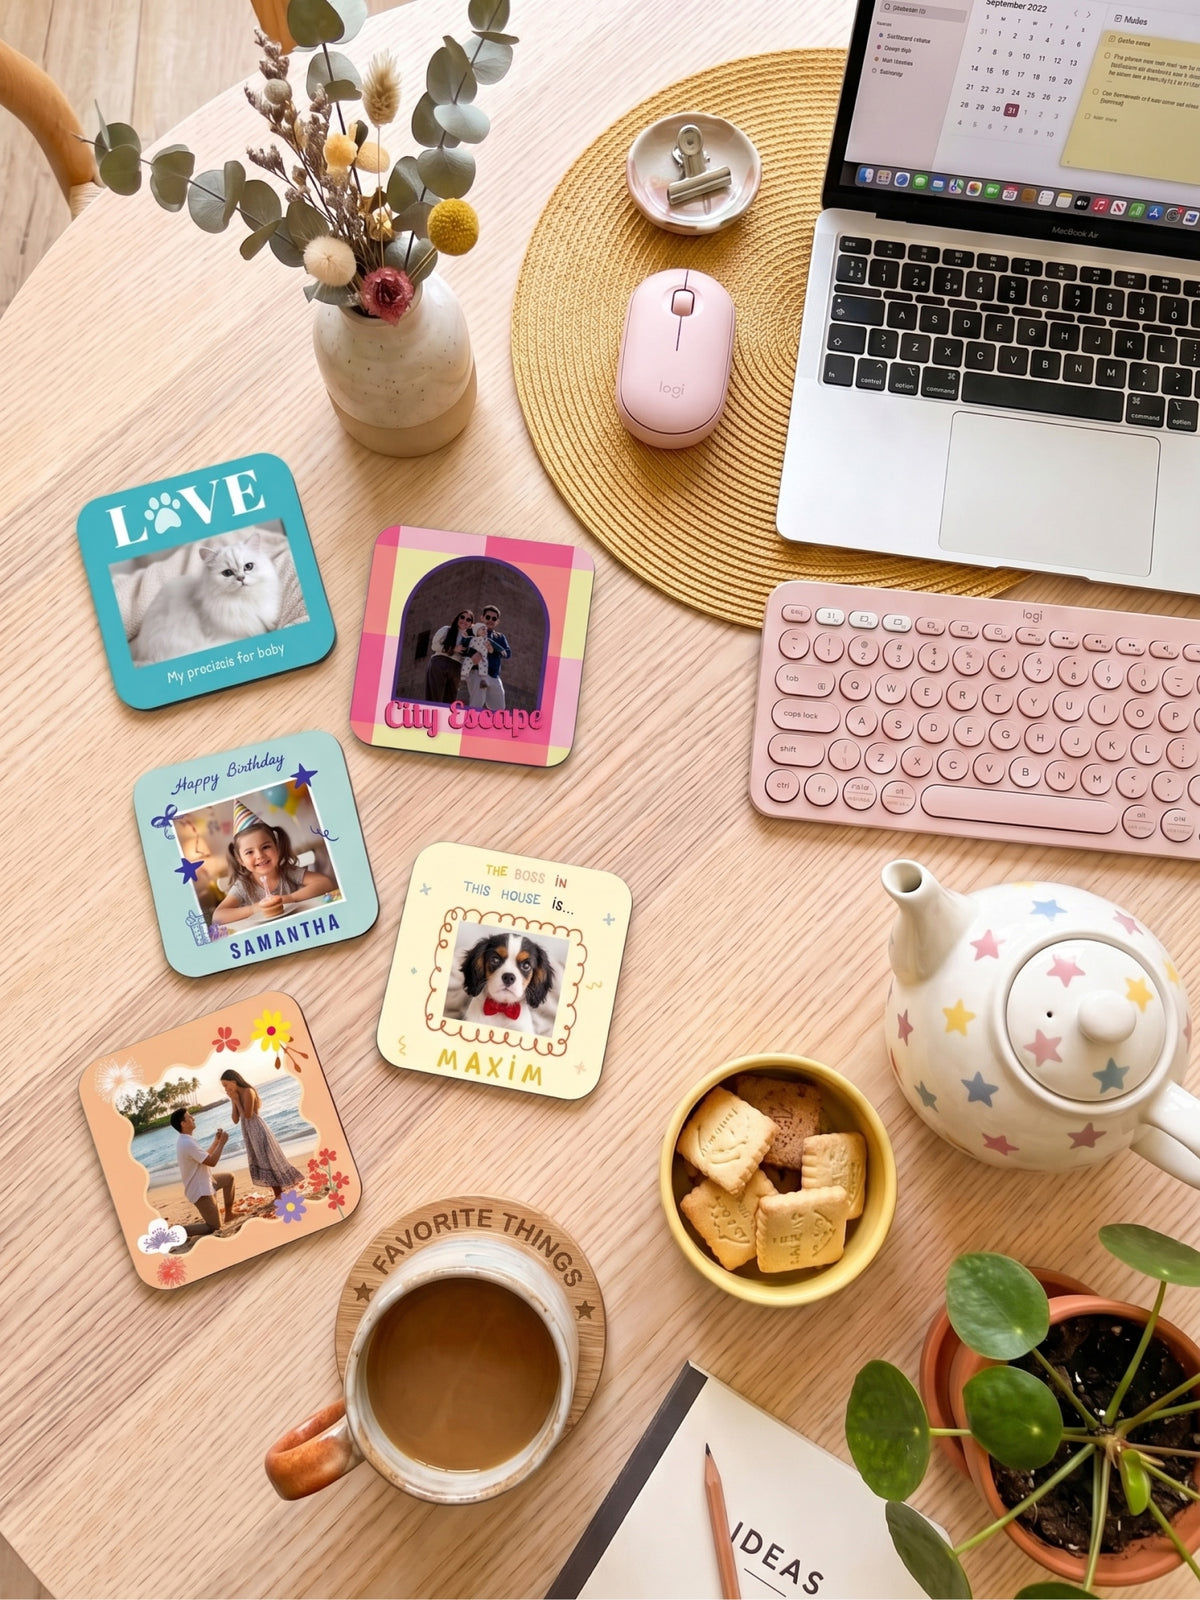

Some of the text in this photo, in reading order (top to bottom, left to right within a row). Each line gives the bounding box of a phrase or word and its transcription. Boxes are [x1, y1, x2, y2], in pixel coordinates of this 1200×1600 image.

[986, 0, 1048, 13] September 2022
[1052, 226, 1099, 239] MacBook Air
[945, 282, 950, 290] 3
[1139, 307, 1145, 315] 9
[1171, 311, 1177, 319] 0
[931, 315, 938, 323] S
[964, 320, 970, 328] D
[997, 324, 1003, 332] F
[1029, 328, 1035, 336] G
[1061, 332, 1068, 340] H
[1127, 341, 1133, 349] K
[1160, 345, 1165, 353] L
[912, 343, 1115, 377] Z X C V B N M
[658, 381, 685, 399] logi
[861, 377, 881, 385] control
[926, 386, 955, 394] command
[1131, 413, 1160, 421] command
[105, 469, 266, 549] LVE
[1022, 609, 1043, 623] logi
[167, 671, 184, 685] My
[236, 650, 255, 665] for
[258, 644, 285, 659] baby
[861, 652, 866, 660] 2
[384, 700, 544, 738] City Escape
[851, 681, 859, 689] Q
[887, 684, 896, 692] W
[924, 688, 930, 696] E
[960, 691, 966, 699] R
[1031, 698, 1037, 706] Y
[1066, 702, 1072, 710] U
[1102, 705, 1106, 713] I
[1136, 709, 1144, 717] O
[1173, 712, 1179, 720] P
[858, 717, 865, 725] A
[895, 720, 901, 729] S
[930, 724, 937, 732] D
[967, 727, 972, 735] F
[1002, 730, 1010, 739] G
[1037, 734, 1044, 742] H
[1109, 742, 1115, 750] K
[1145, 745, 1150, 753] L
[171, 752, 285, 795] Happy Birthday
[780, 745, 796, 753] shift
[877, 753, 884, 762] Z
[914, 757, 921, 766] X
[950, 761, 957, 769] C
[1022, 768, 1029, 776] B
[1093, 775, 1101, 783] M
[486, 864, 508, 877] THE
[514, 868, 546, 885] BOSS
[501, 889, 542, 905] HOUSE
[230, 914, 340, 959] SAMANTHA
[372, 1208, 583, 1287] FAVORITE THINGS
[731, 1521, 824, 1595] IDEAS
